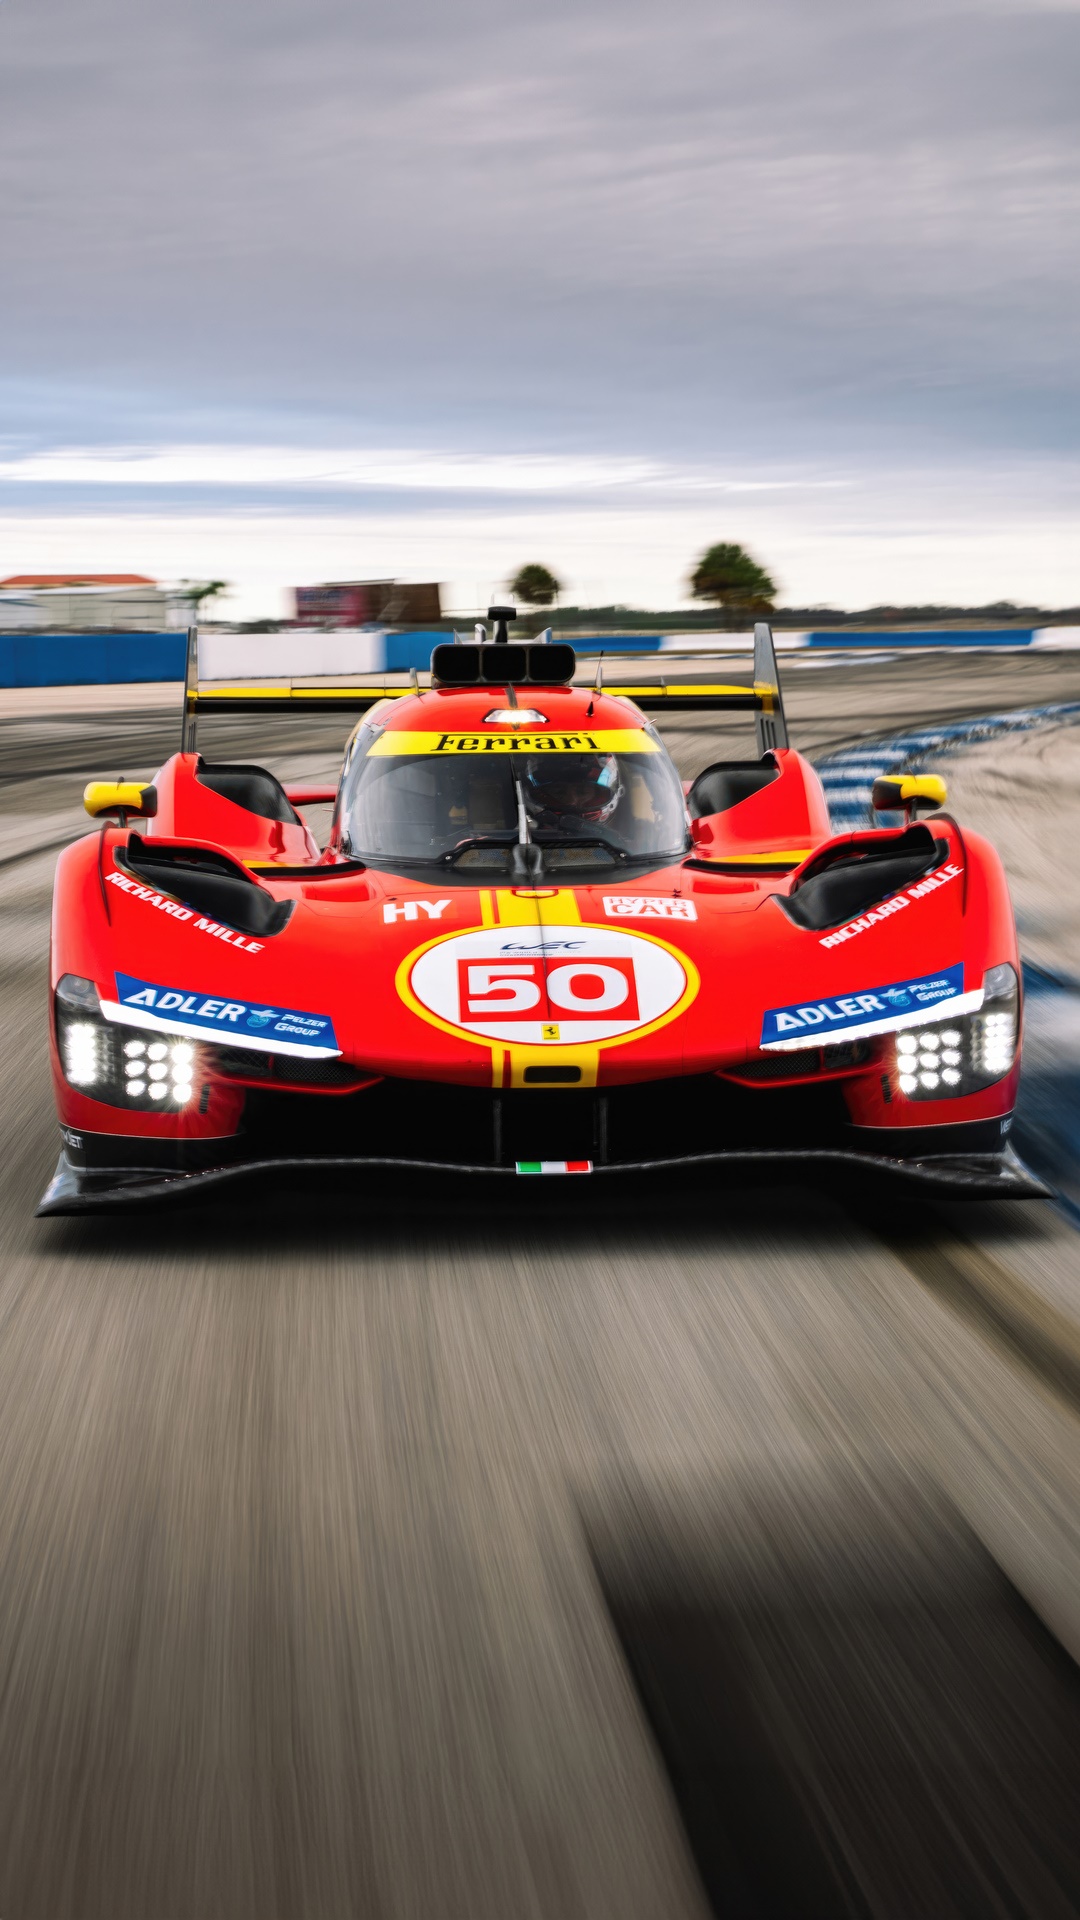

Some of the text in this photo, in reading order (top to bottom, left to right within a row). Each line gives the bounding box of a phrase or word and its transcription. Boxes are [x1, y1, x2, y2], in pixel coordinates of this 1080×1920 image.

[430, 732, 601, 751] Ferrari
[105, 871, 266, 954] RICHARD MILLE
[382, 899, 452, 924] HY
[609, 898, 687, 907] HYPER
[611, 904, 689, 917] CAR
[818, 863, 965, 949] RICHARD MILLE
[500, 941, 588, 950] WEC
[467, 963, 629, 1012] 50
[123, 988, 247, 1022] ADLER
[774, 994, 888, 1032] ADLER
